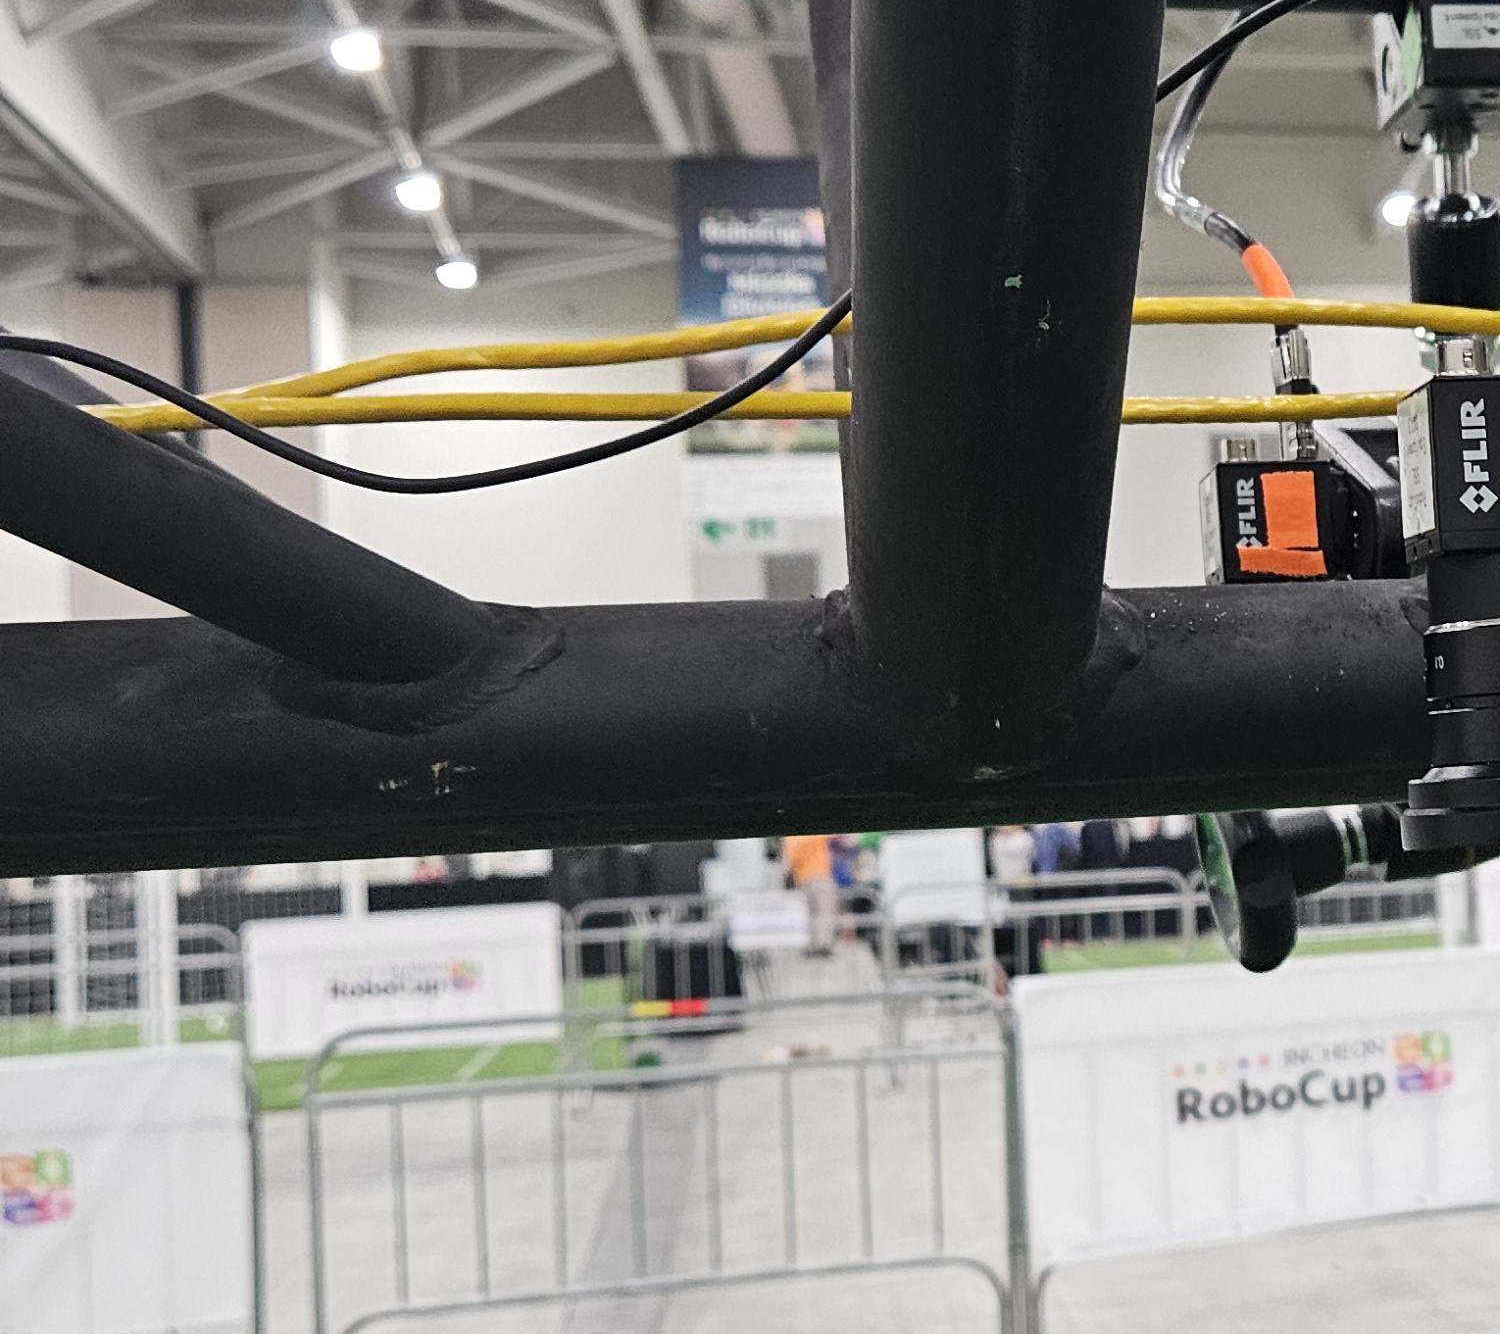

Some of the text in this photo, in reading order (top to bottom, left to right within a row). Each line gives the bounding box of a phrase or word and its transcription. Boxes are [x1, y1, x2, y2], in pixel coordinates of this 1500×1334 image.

[1460, 397, 1490, 484] FLIR
[1236, 476, 1258, 535] FLIR
[1175, 1068, 1387, 1124] RoboCup
